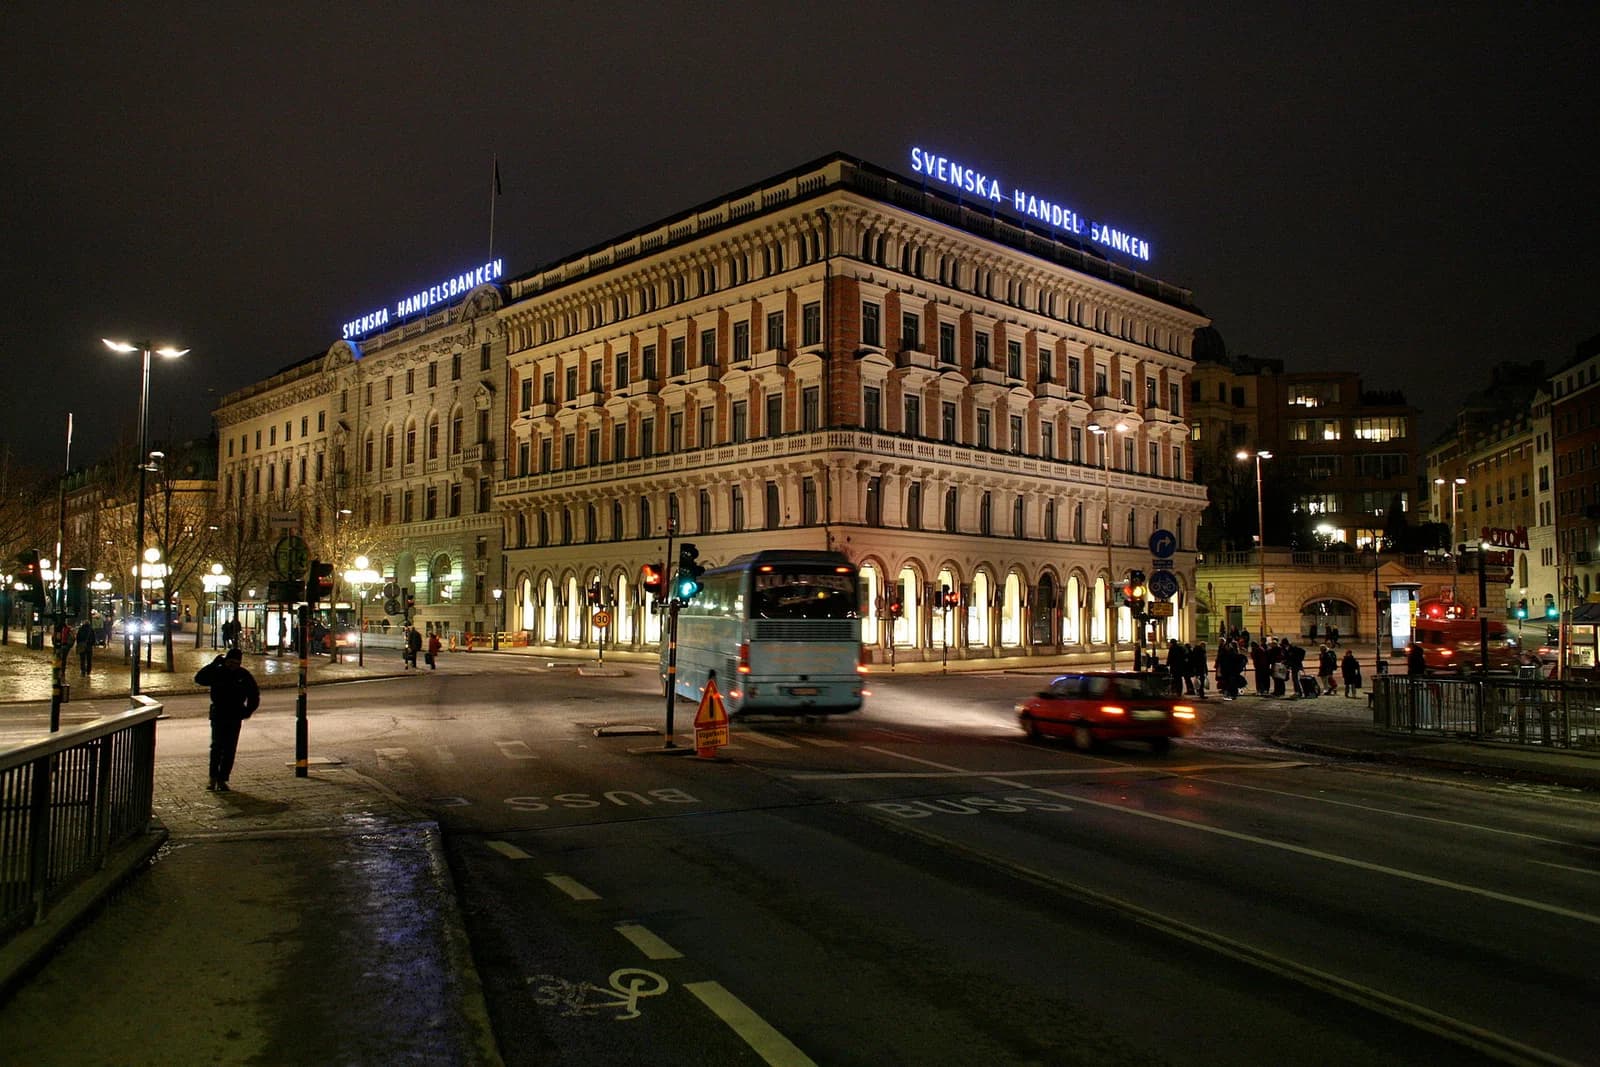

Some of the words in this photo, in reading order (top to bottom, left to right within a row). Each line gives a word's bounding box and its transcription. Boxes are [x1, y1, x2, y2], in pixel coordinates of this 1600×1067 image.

[911, 147, 1001, 203] SVENSKA
[342, 308, 389, 340] SVENSKA
[397, 258, 503, 318] HANDELSBANKEN
[597, 615, 608, 624] 30
[503, 787, 701, 812] BUSS
[868, 797, 1073, 819] BUSS
